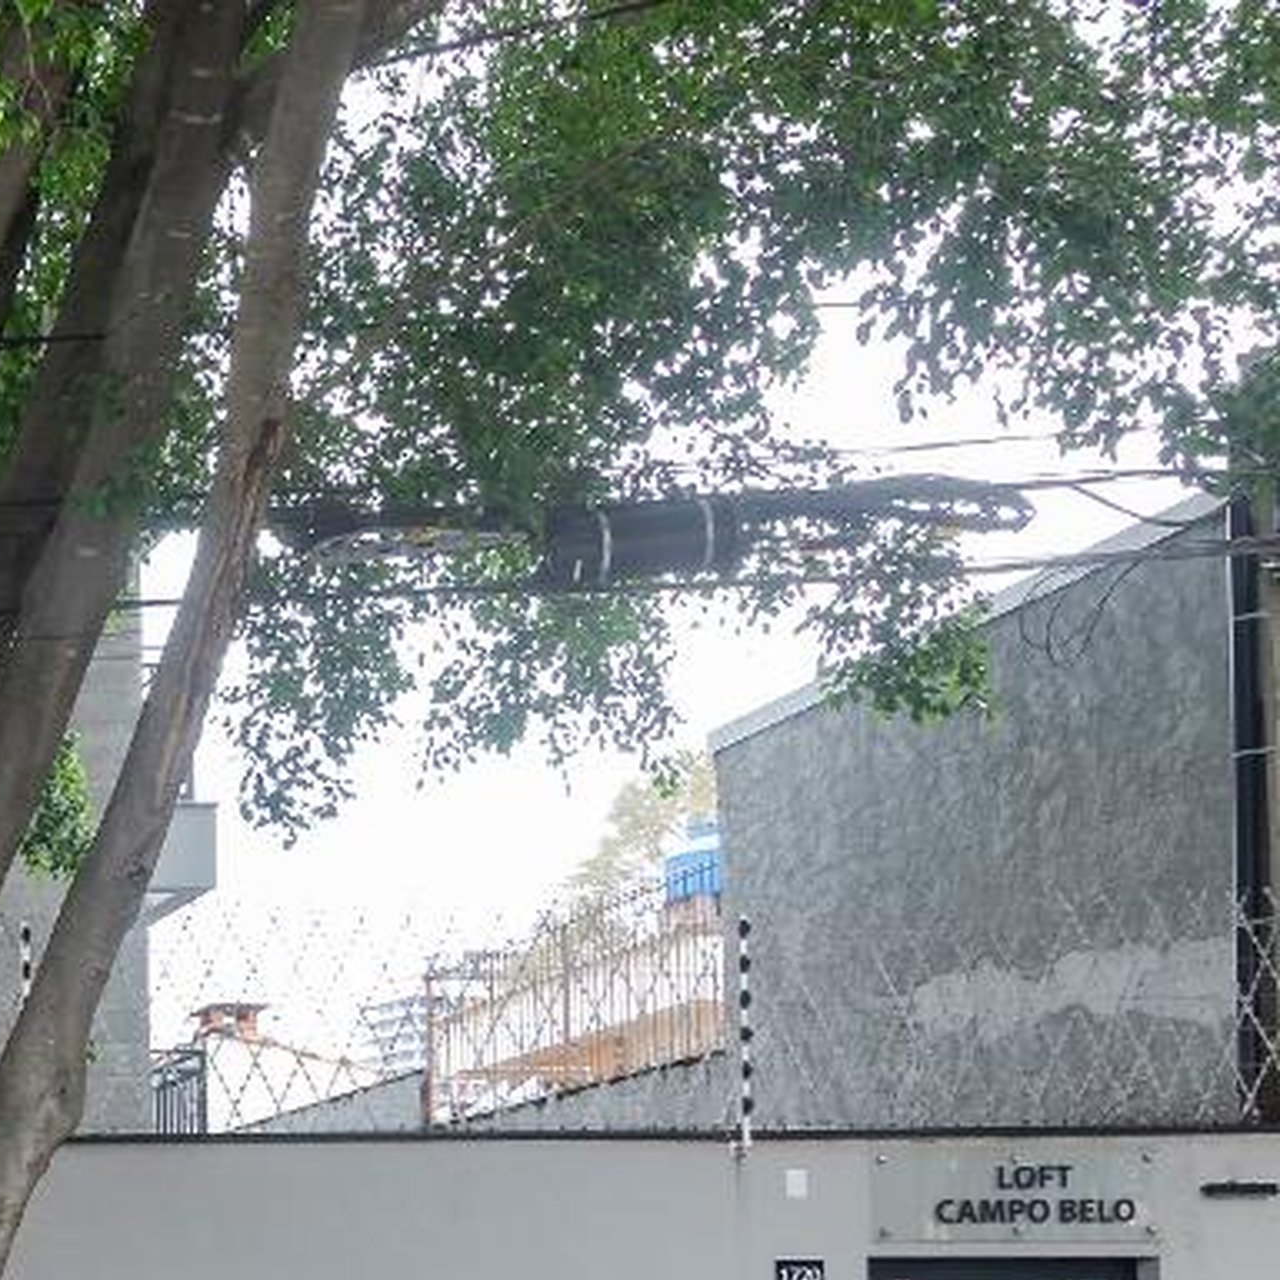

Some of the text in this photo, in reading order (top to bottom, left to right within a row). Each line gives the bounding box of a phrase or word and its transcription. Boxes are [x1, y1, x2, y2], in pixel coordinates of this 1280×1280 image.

[996, 1165, 1073, 1190] LOFT
[935, 1198, 1137, 1224] CAMPO BELO
